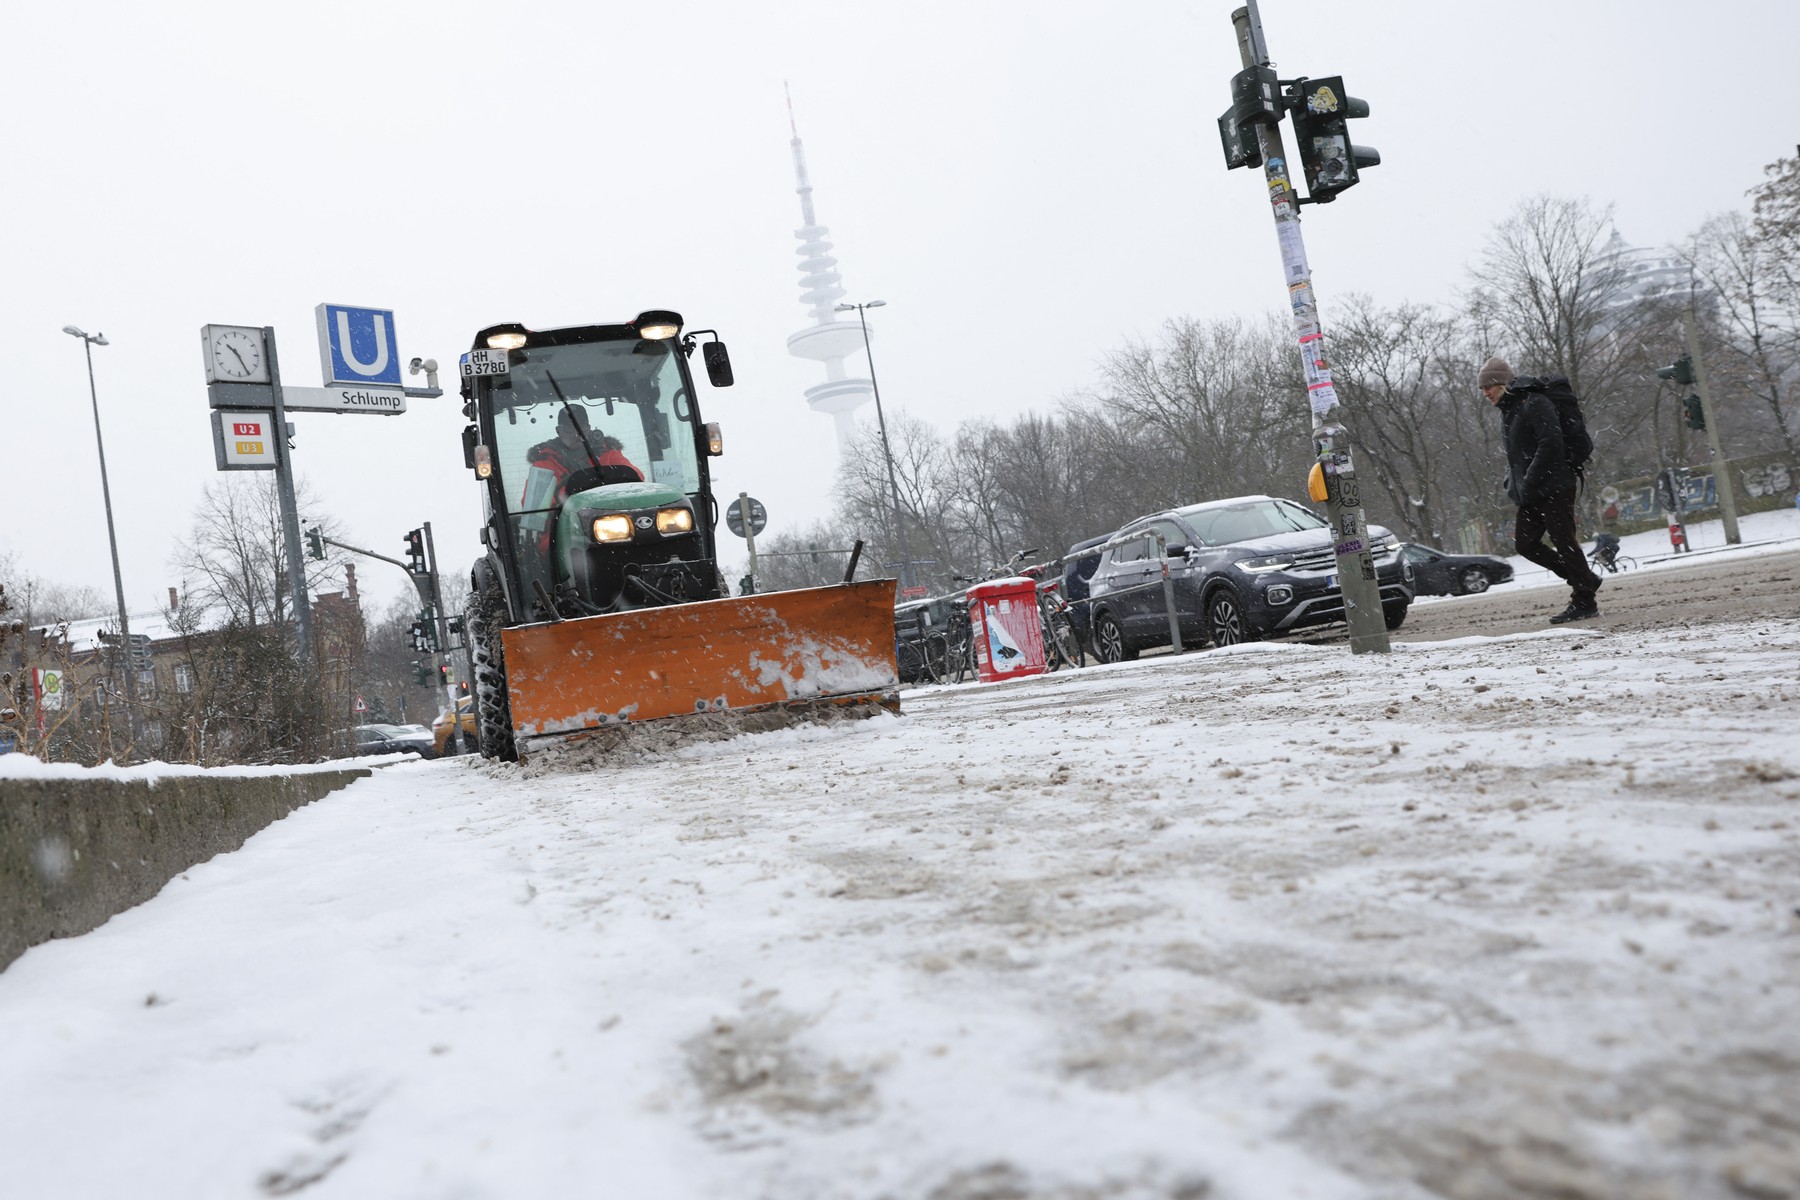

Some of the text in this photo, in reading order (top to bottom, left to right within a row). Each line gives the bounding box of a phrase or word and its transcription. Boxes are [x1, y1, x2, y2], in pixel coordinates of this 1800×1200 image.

[336, 311, 389, 376] U
[472, 351, 488, 362] HH
[475, 362, 506, 375] 3780
[342, 391, 401, 409] Schlump
